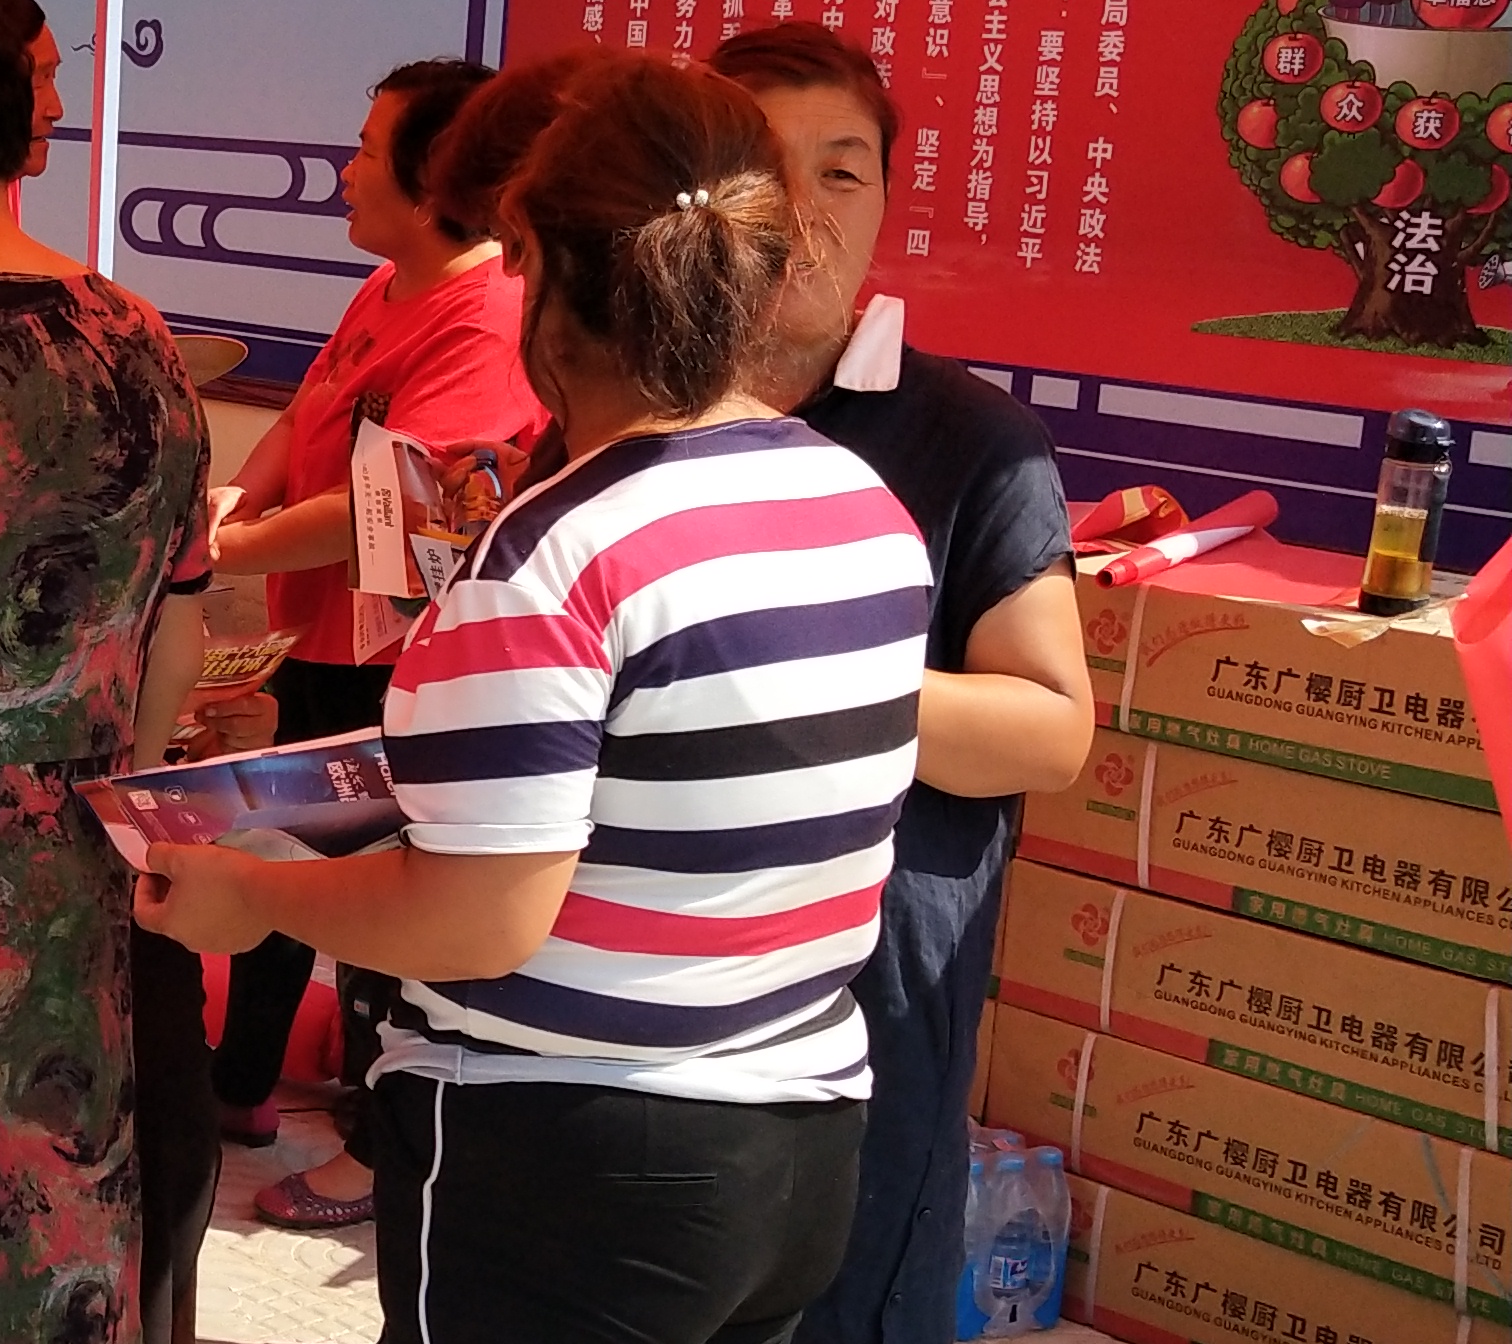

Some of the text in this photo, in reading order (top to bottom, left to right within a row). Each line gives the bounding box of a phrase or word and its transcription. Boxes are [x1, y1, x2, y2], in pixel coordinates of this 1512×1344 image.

[1275, 46, 1445, 140] 群 众 获
[1386, 209, 1444, 295] 法治
[1206, 684, 1293, 713] GUANGDONG
[1294, 701, 1378, 731] GUANGYING
[1381, 719, 1443, 743] KITCHEN
[1210, 655, 1480, 733] 广东广樱厨卫电器
[1249, 738, 1295, 761] HOME
[1297, 747, 1332, 768] GAS
[1172, 836, 1255, 868] GUANGDONG
[1257, 857, 1338, 887] GUANGYING
[1340, 878, 1401, 903] KITCHEN
[1403, 894, 1495, 926] APPLIANCES
[1153, 989, 1236, 1022] GUANGDONG
[1238, 1010, 1318, 1045] GUANGYING
[1319, 1035, 1379, 1063] KITCHEN
[1380, 1055, 1471, 1090] APPLIANCES
[1155, 962, 1512, 1084] 广东广樱厨卫电器有限公
[1132, 1135, 1213, 1171] GUANGDONG
[1214, 1162, 1292, 1201] GUANGYING
[1294, 1190, 1353, 1220] KITCHEN
[1354, 1212, 1443, 1252] APPLIANCES
[1130, 1286, 1211, 1322] GUANGDONG
